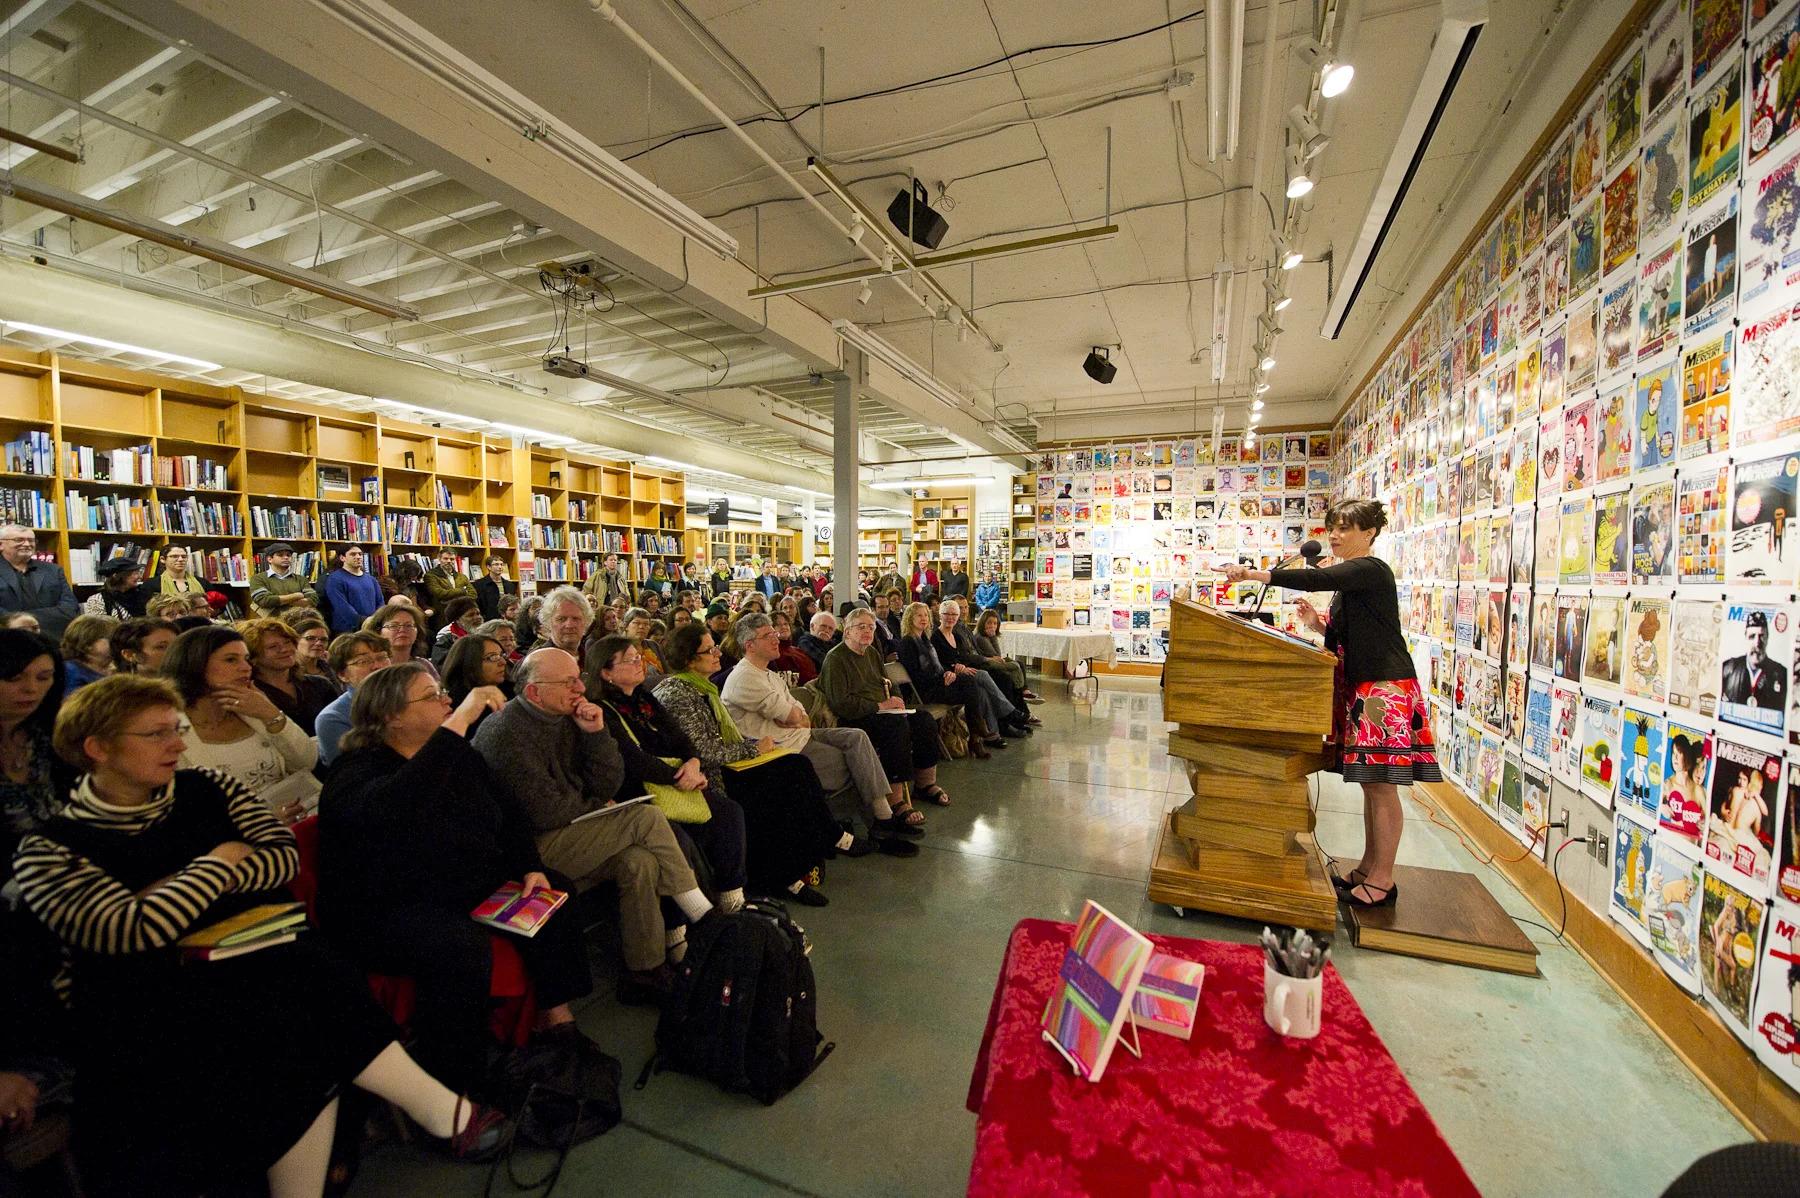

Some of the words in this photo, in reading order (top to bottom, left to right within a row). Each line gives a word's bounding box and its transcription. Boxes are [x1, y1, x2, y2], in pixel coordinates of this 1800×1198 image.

[1685, 347, 1721, 369] MERCURY
[1736, 458, 1786, 484] MERCURY
[1680, 479, 1716, 493] MERCURY
[1585, 698, 1611, 715] MERCURY
[1717, 742, 1768, 771] MERCURY
[1669, 798, 1683, 813] SEX
[1682, 809, 1701, 823] ISSUE
[1764, 1022, 1795, 1044] EXPLOSION
[1774, 1019, 1786, 1031] THE
[1770, 1034, 1788, 1049] ISSUE
